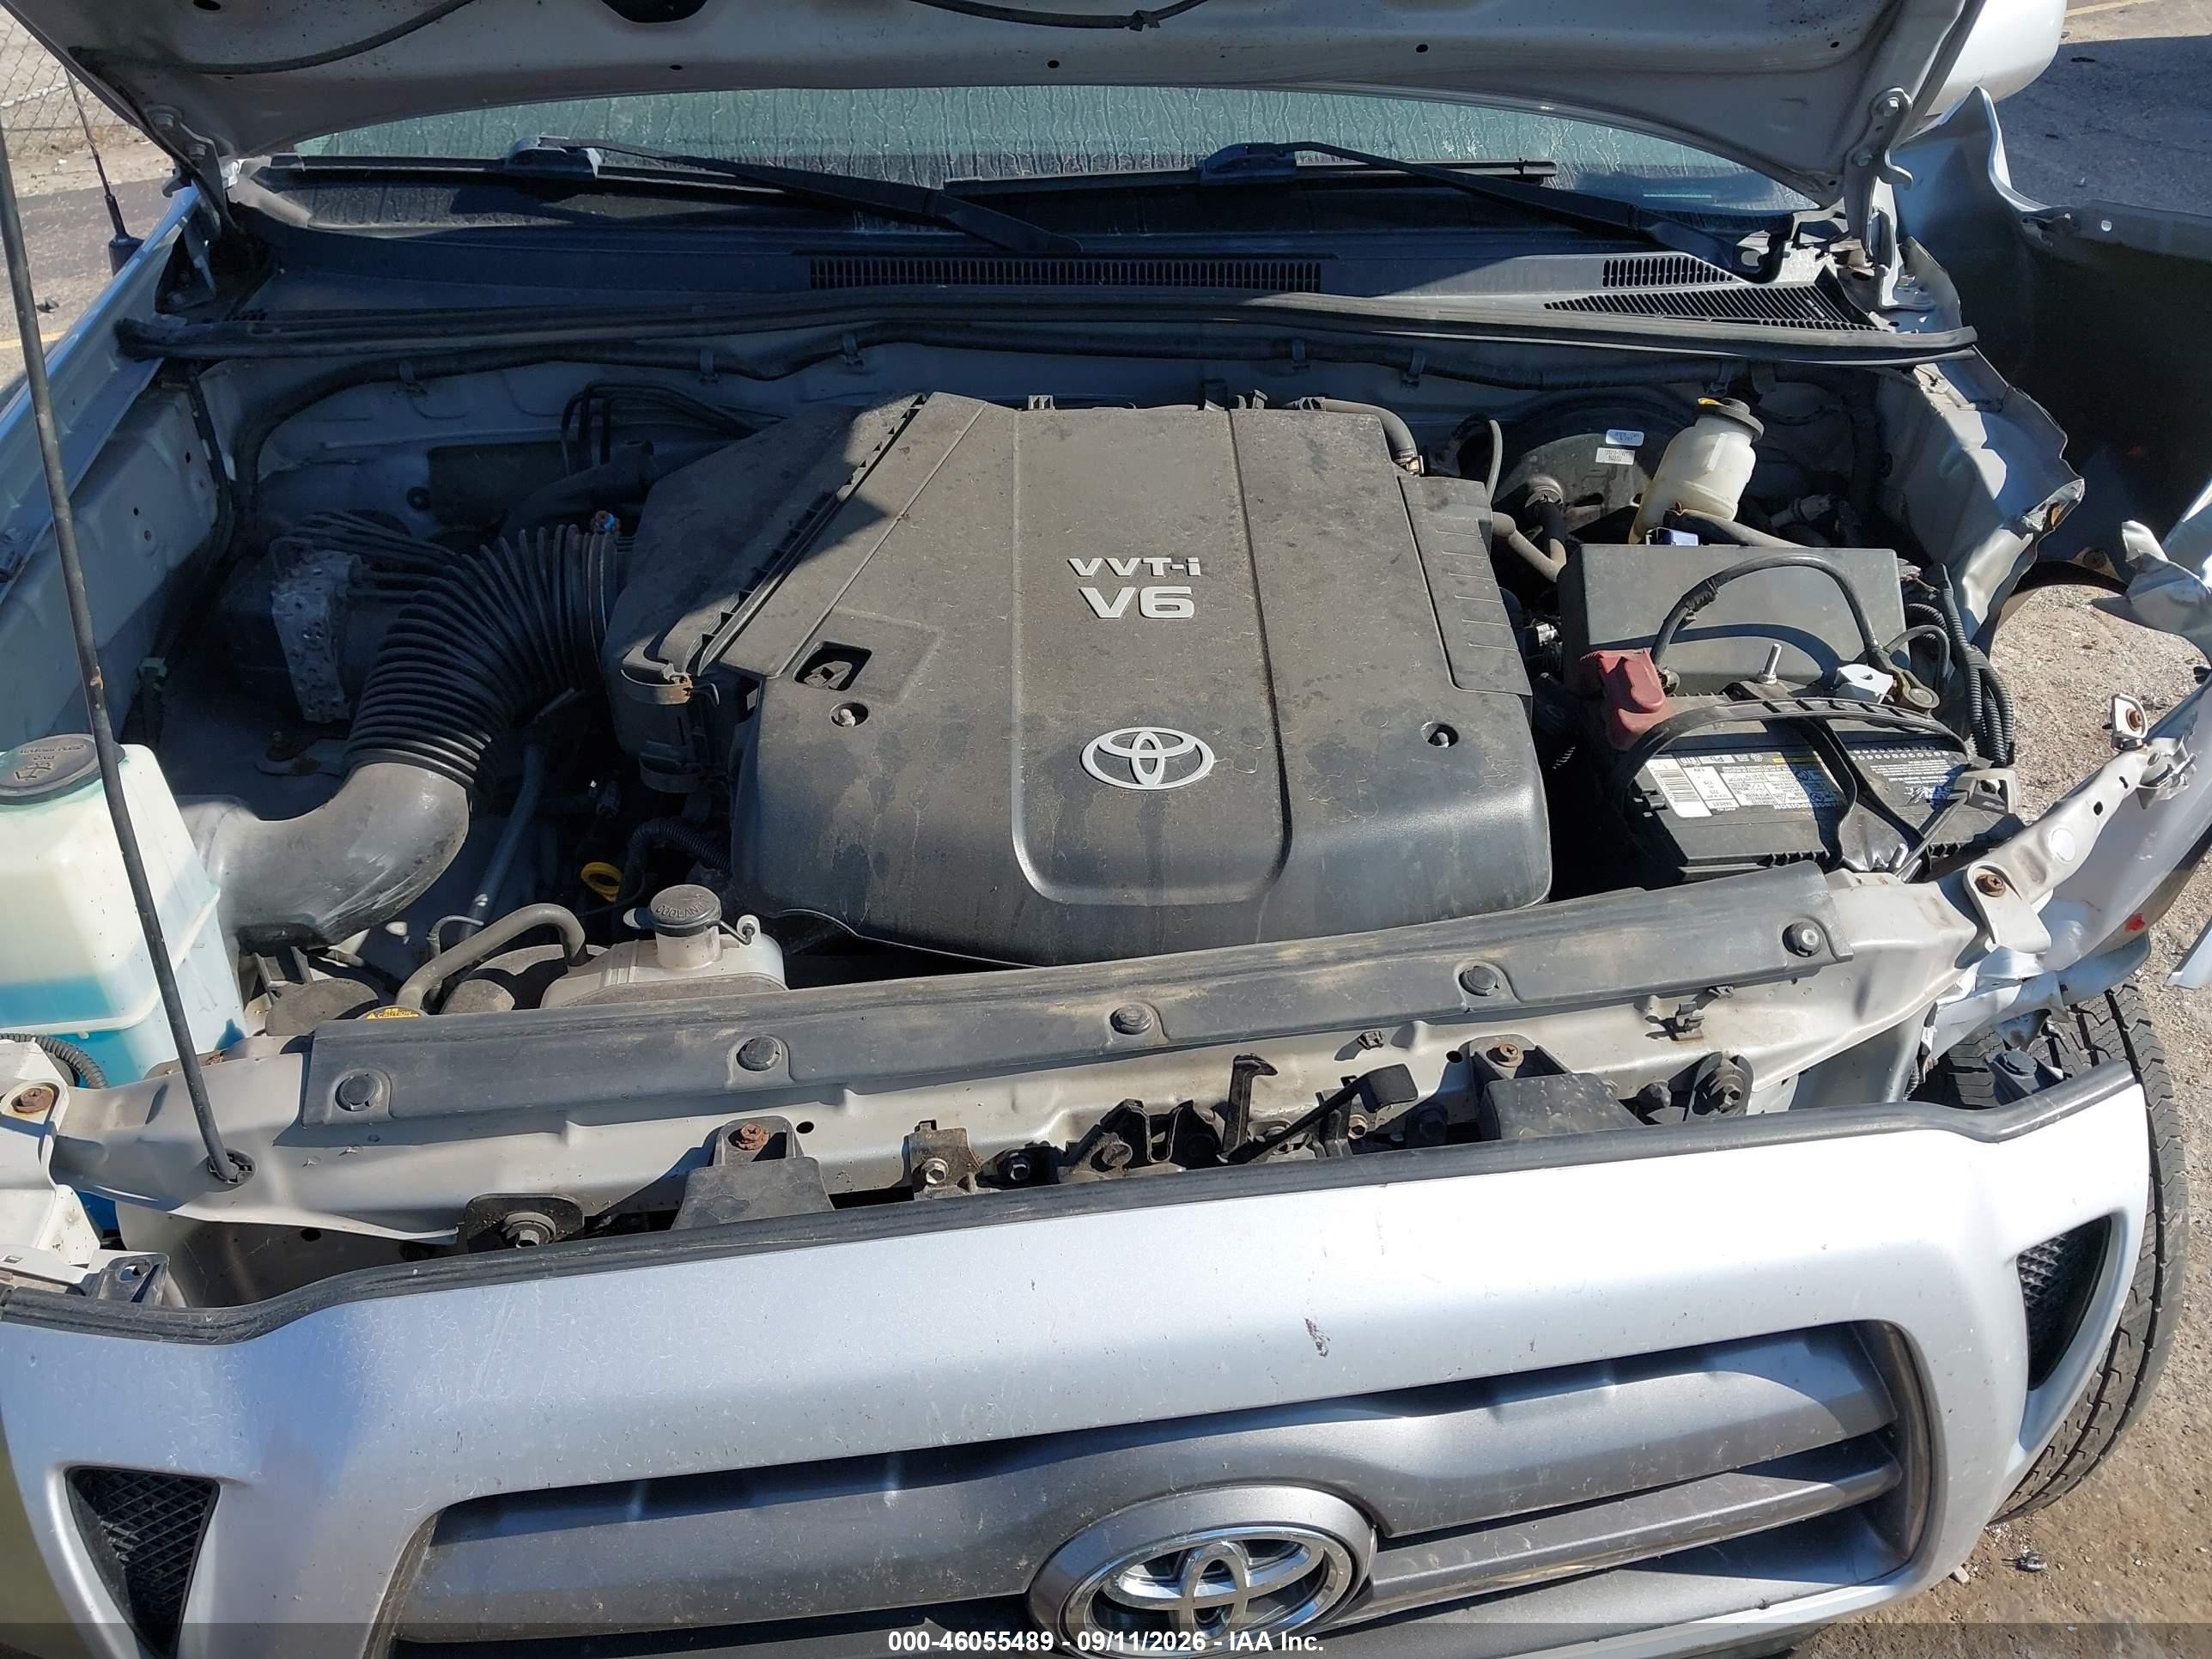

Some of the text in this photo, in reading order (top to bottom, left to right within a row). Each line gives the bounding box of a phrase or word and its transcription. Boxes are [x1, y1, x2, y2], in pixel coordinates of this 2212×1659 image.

[1068, 557, 1200, 576] VVT-i
[1079, 586, 1195, 618] V6
[656, 902, 705, 918] COOLANT
